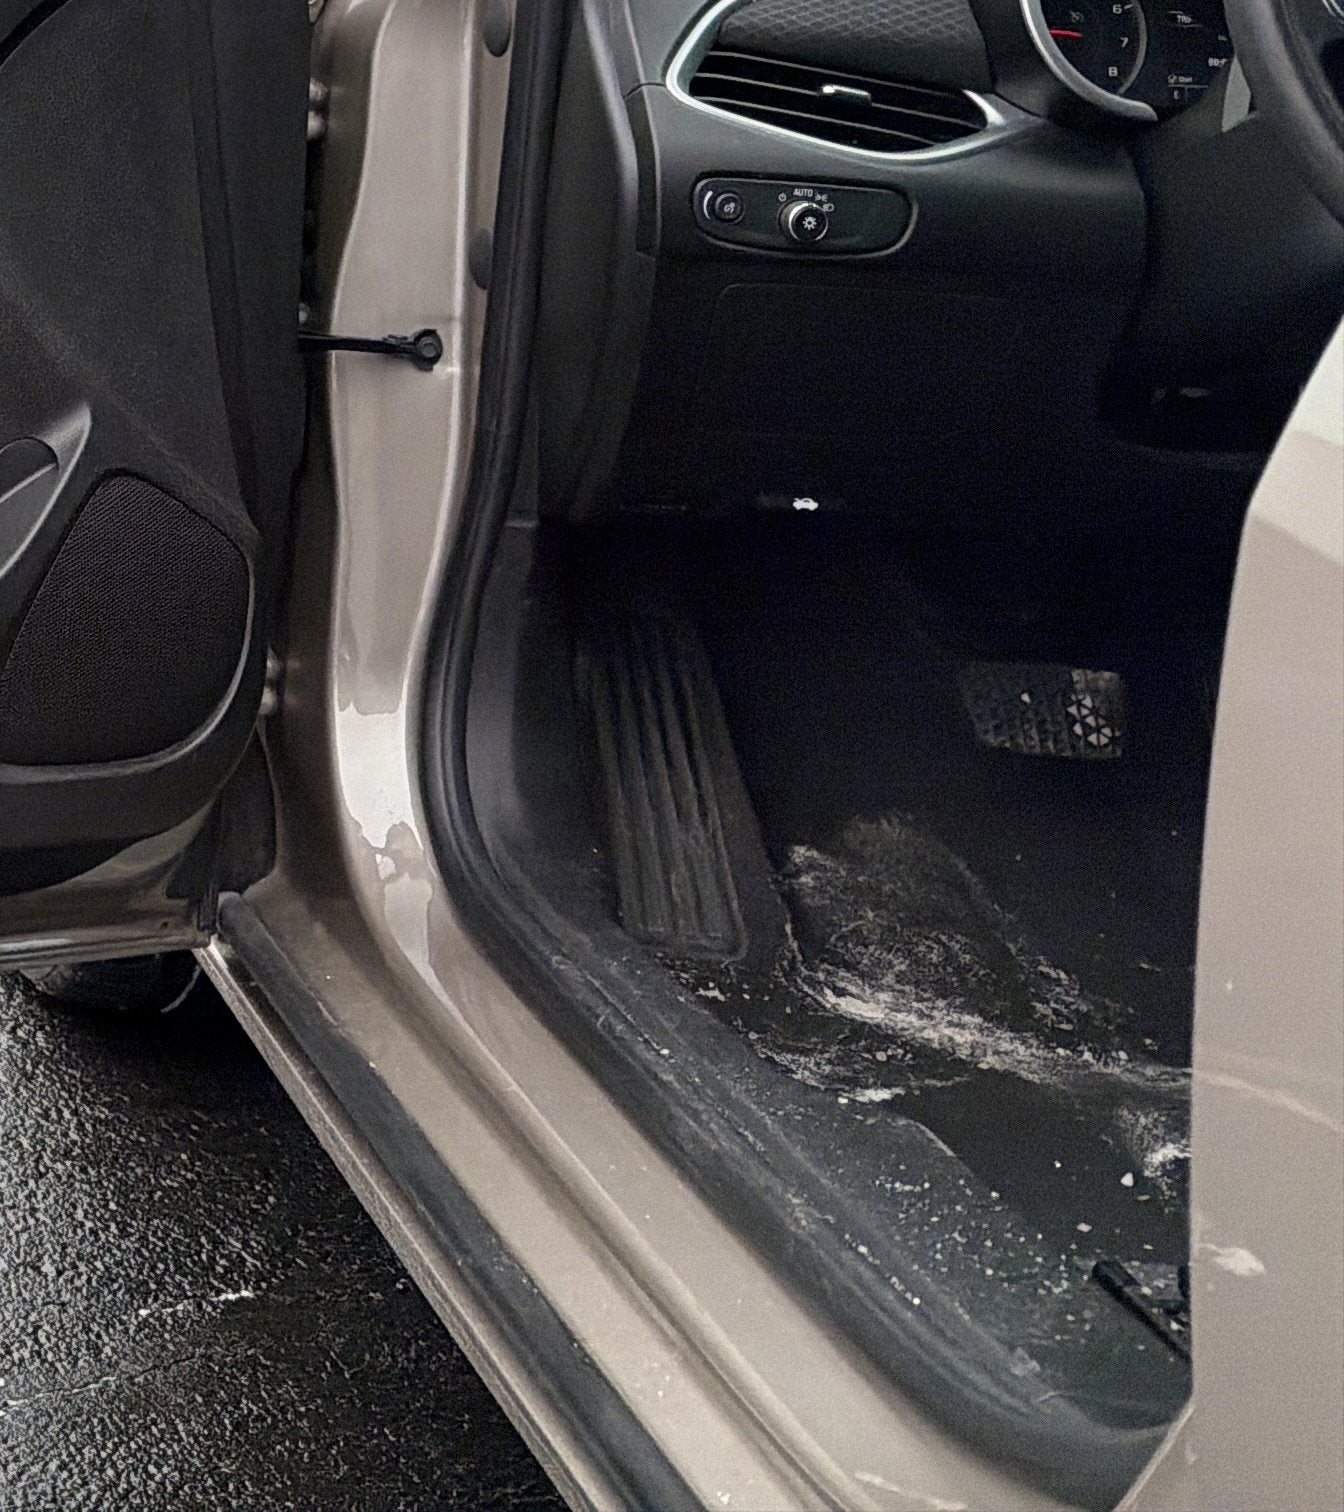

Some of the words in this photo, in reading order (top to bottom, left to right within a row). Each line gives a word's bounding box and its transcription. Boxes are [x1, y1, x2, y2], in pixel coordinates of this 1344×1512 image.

[1112, 4, 1123, 15] 6
[1119, 36, 1129, 48] 7
[793, 188, 814, 198] AUTO
